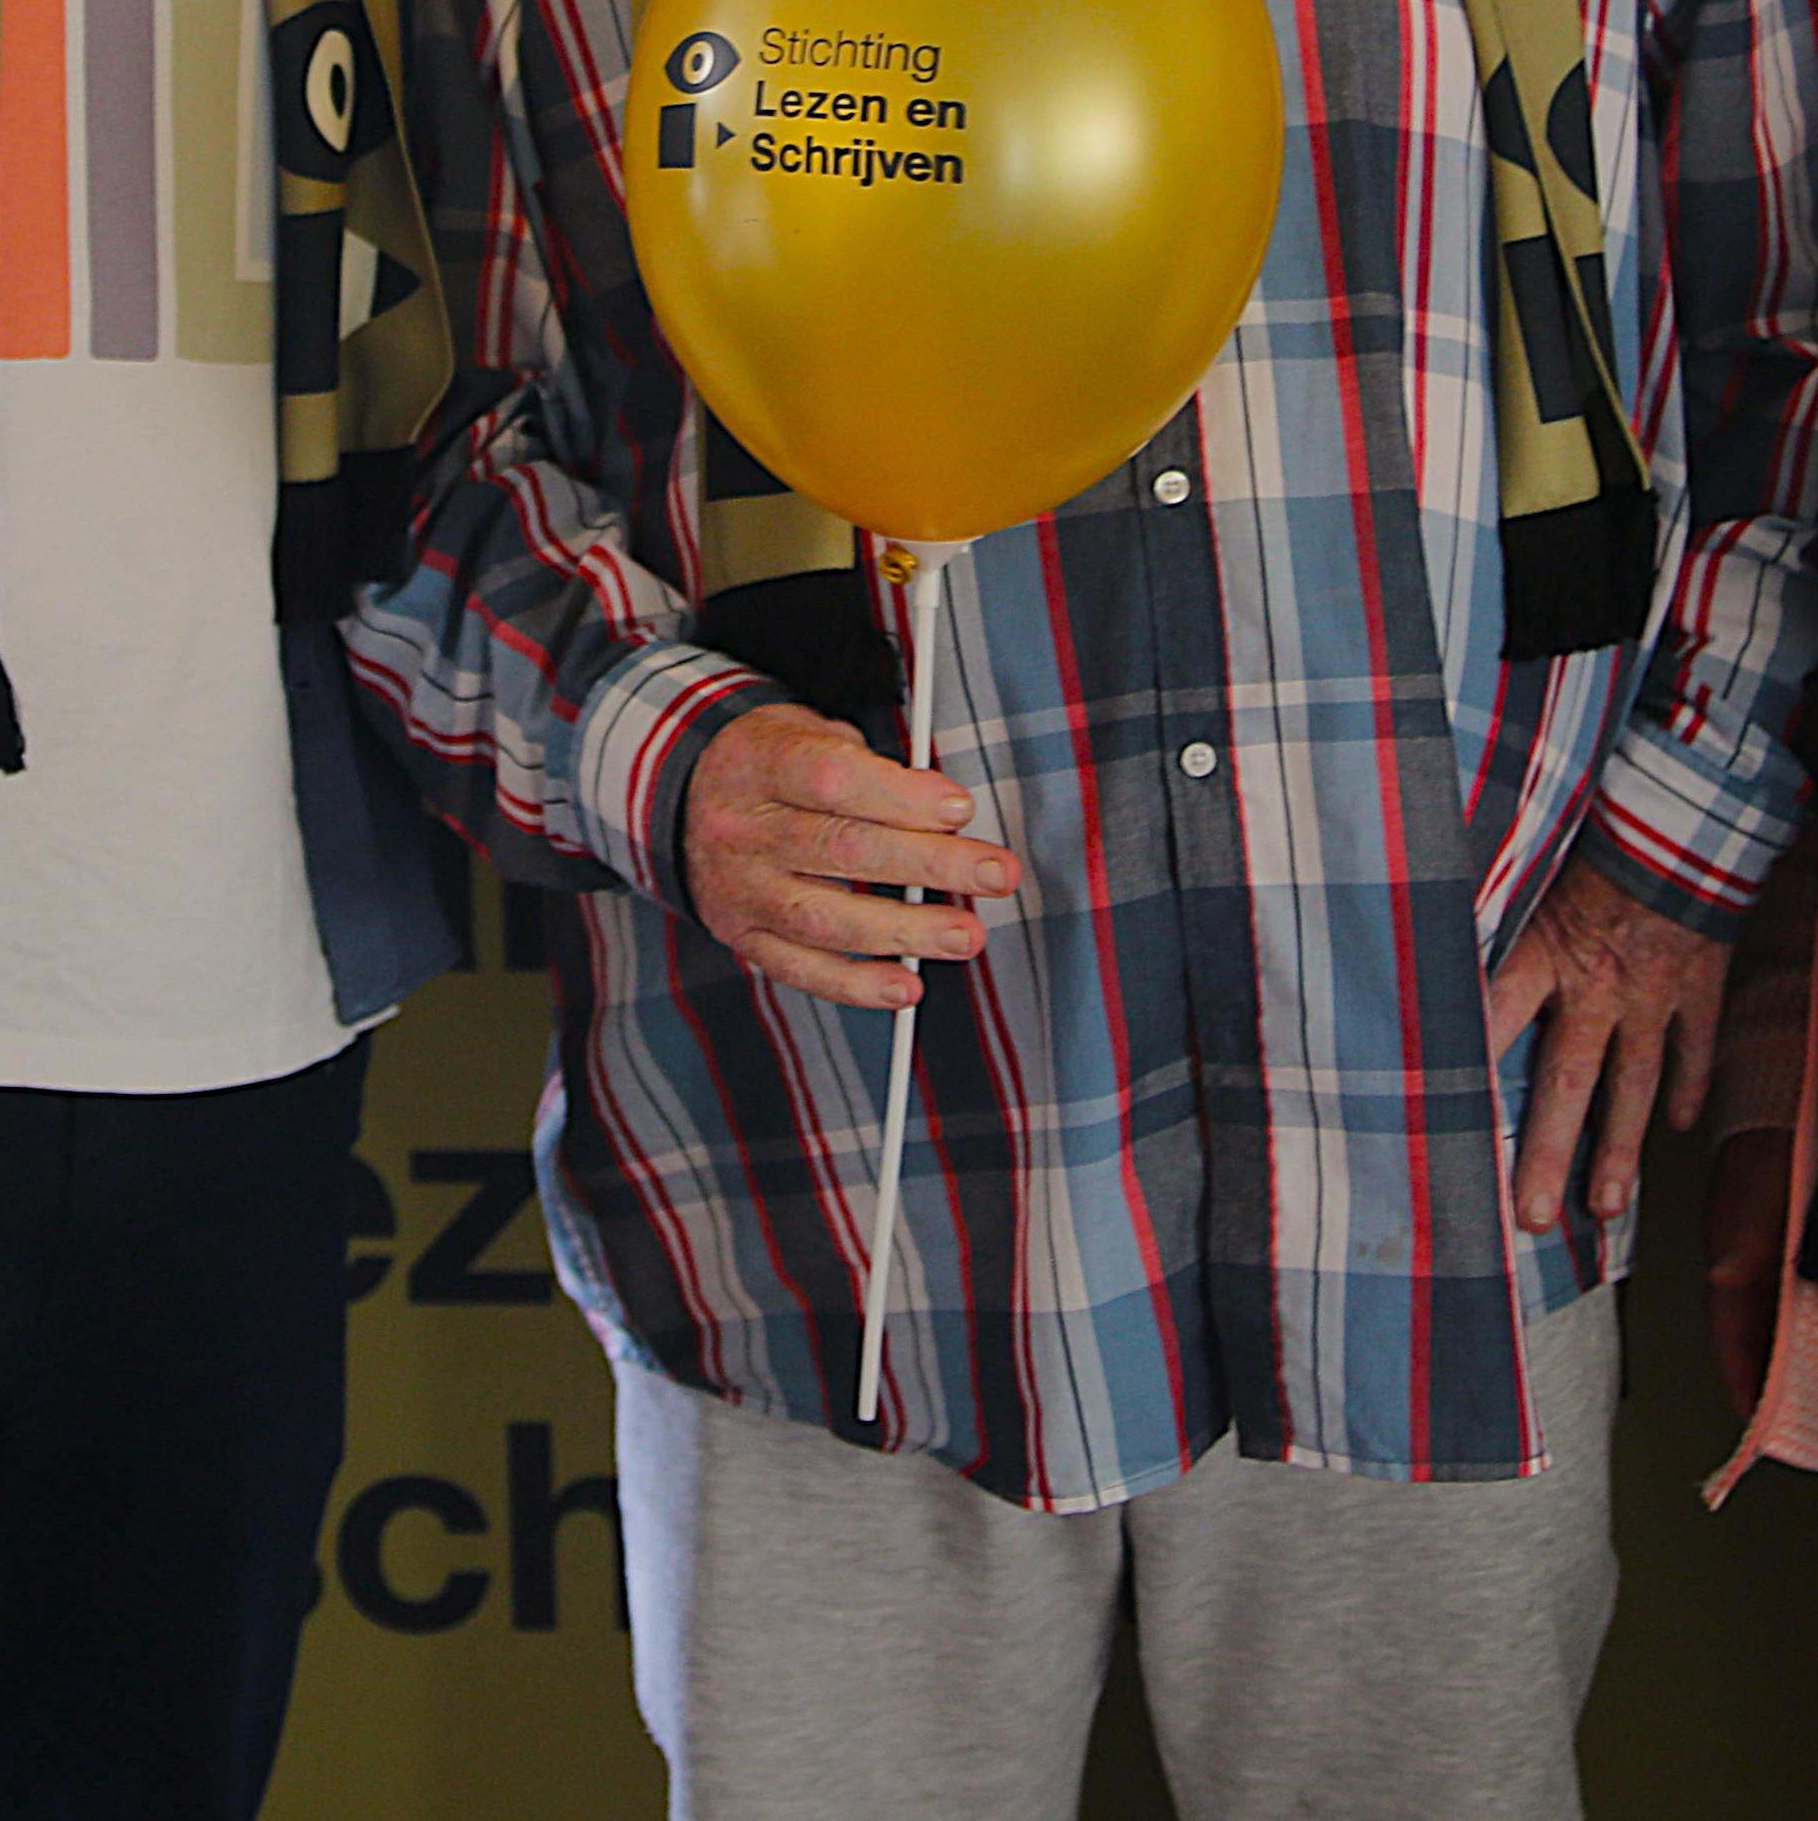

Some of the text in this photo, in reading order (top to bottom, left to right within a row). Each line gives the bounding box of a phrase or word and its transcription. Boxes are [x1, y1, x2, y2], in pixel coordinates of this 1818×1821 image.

[758, 27, 942, 83] Stichting
[754, 80, 966, 130] Lezen en
[750, 132, 964, 187] Schrijven
